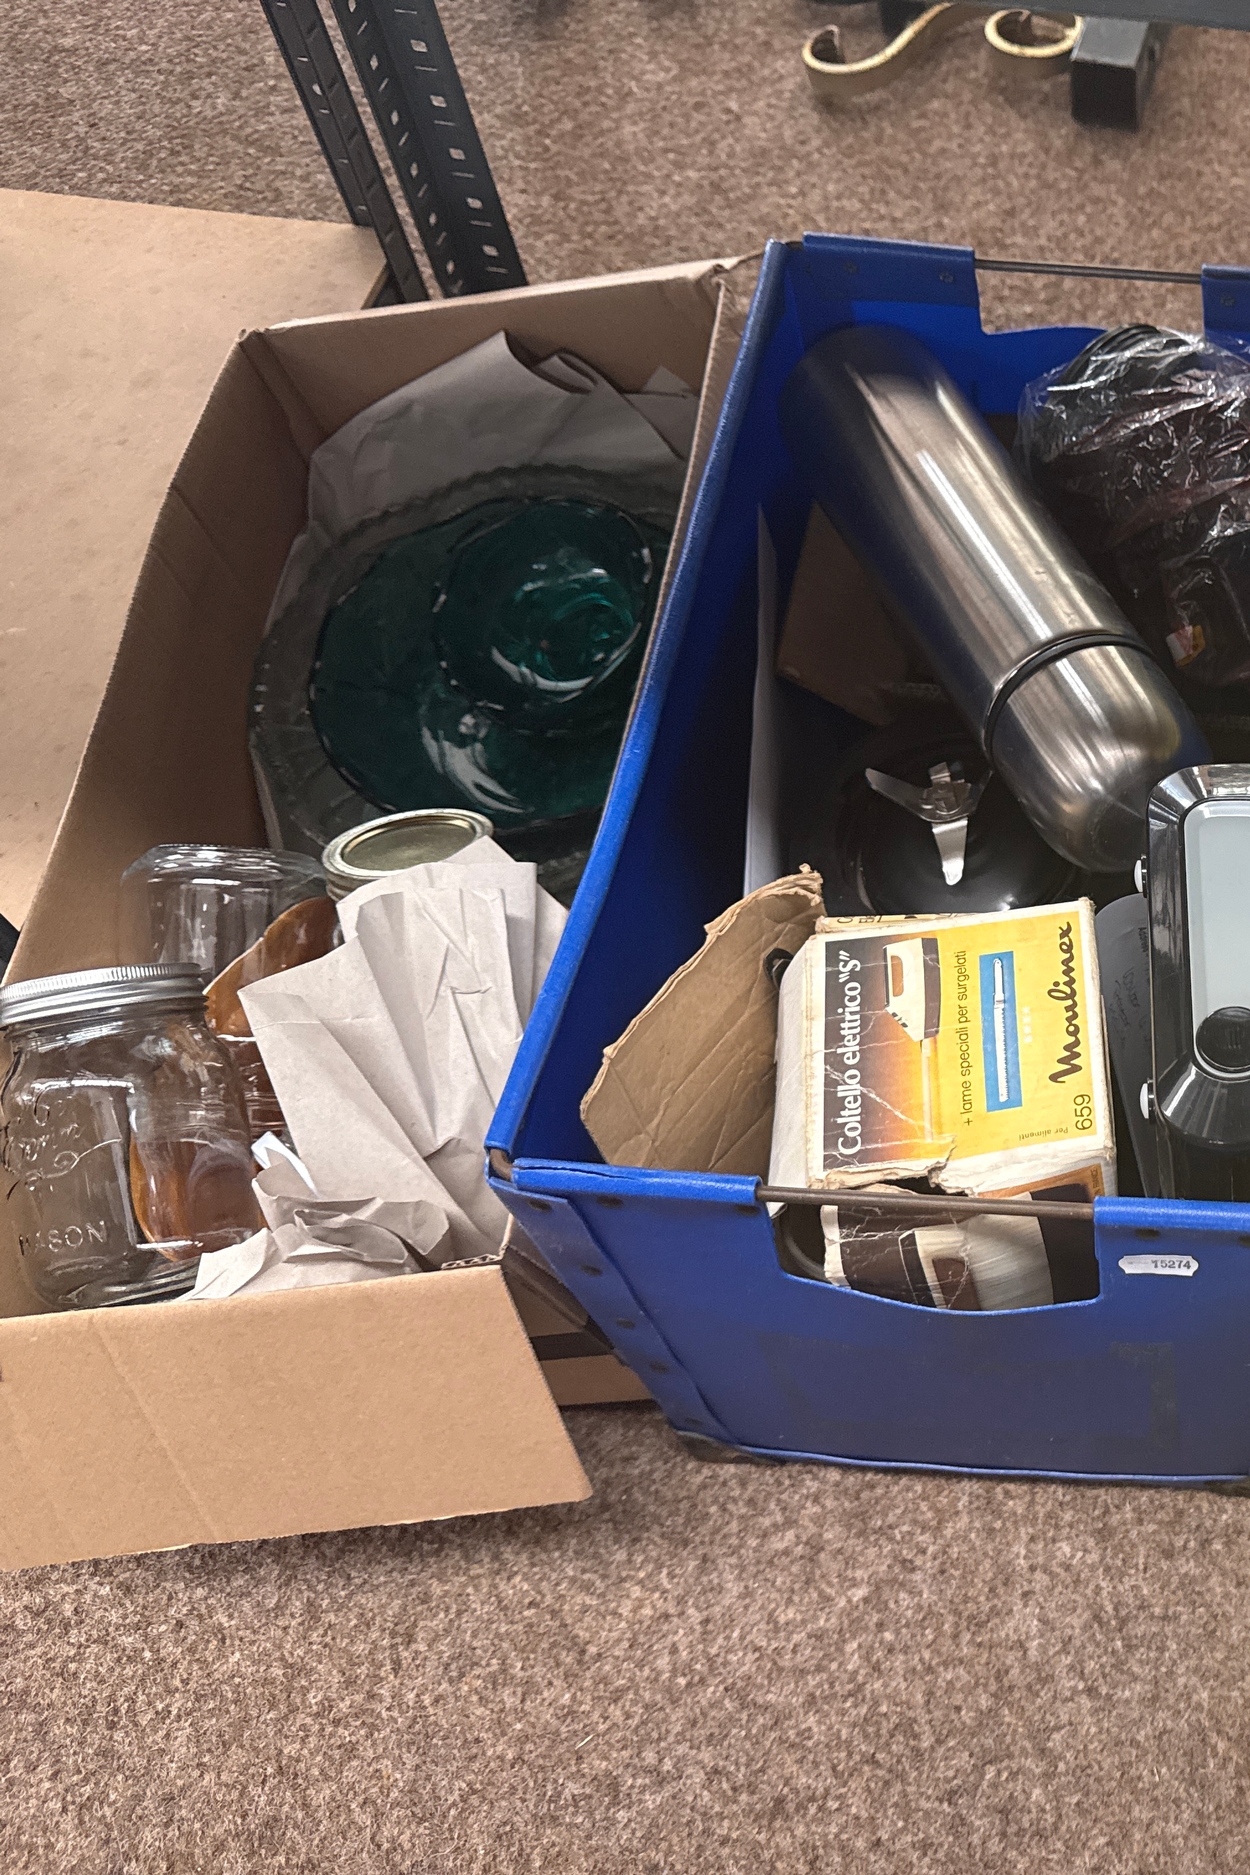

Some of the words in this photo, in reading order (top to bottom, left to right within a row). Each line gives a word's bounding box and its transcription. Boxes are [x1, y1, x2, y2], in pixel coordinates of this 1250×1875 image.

[953, 950, 970, 1002] surgelati
[957, 1005, 971, 1024] per
[1047, 921, 1082, 1085] Moulinex
[836, 981, 861, 1066] elettrico
[955, 1026, 973, 1078] speciali
[837, 1068, 862, 1155] Coltello
[960, 1080, 973, 1115] lame
[1073, 1093, 1094, 1131] 659
[1018, 1129, 1052, 1142] alimenti
[1055, 1126, 1069, 1135] Per
[1151, 1259, 1192, 1270] 15274
